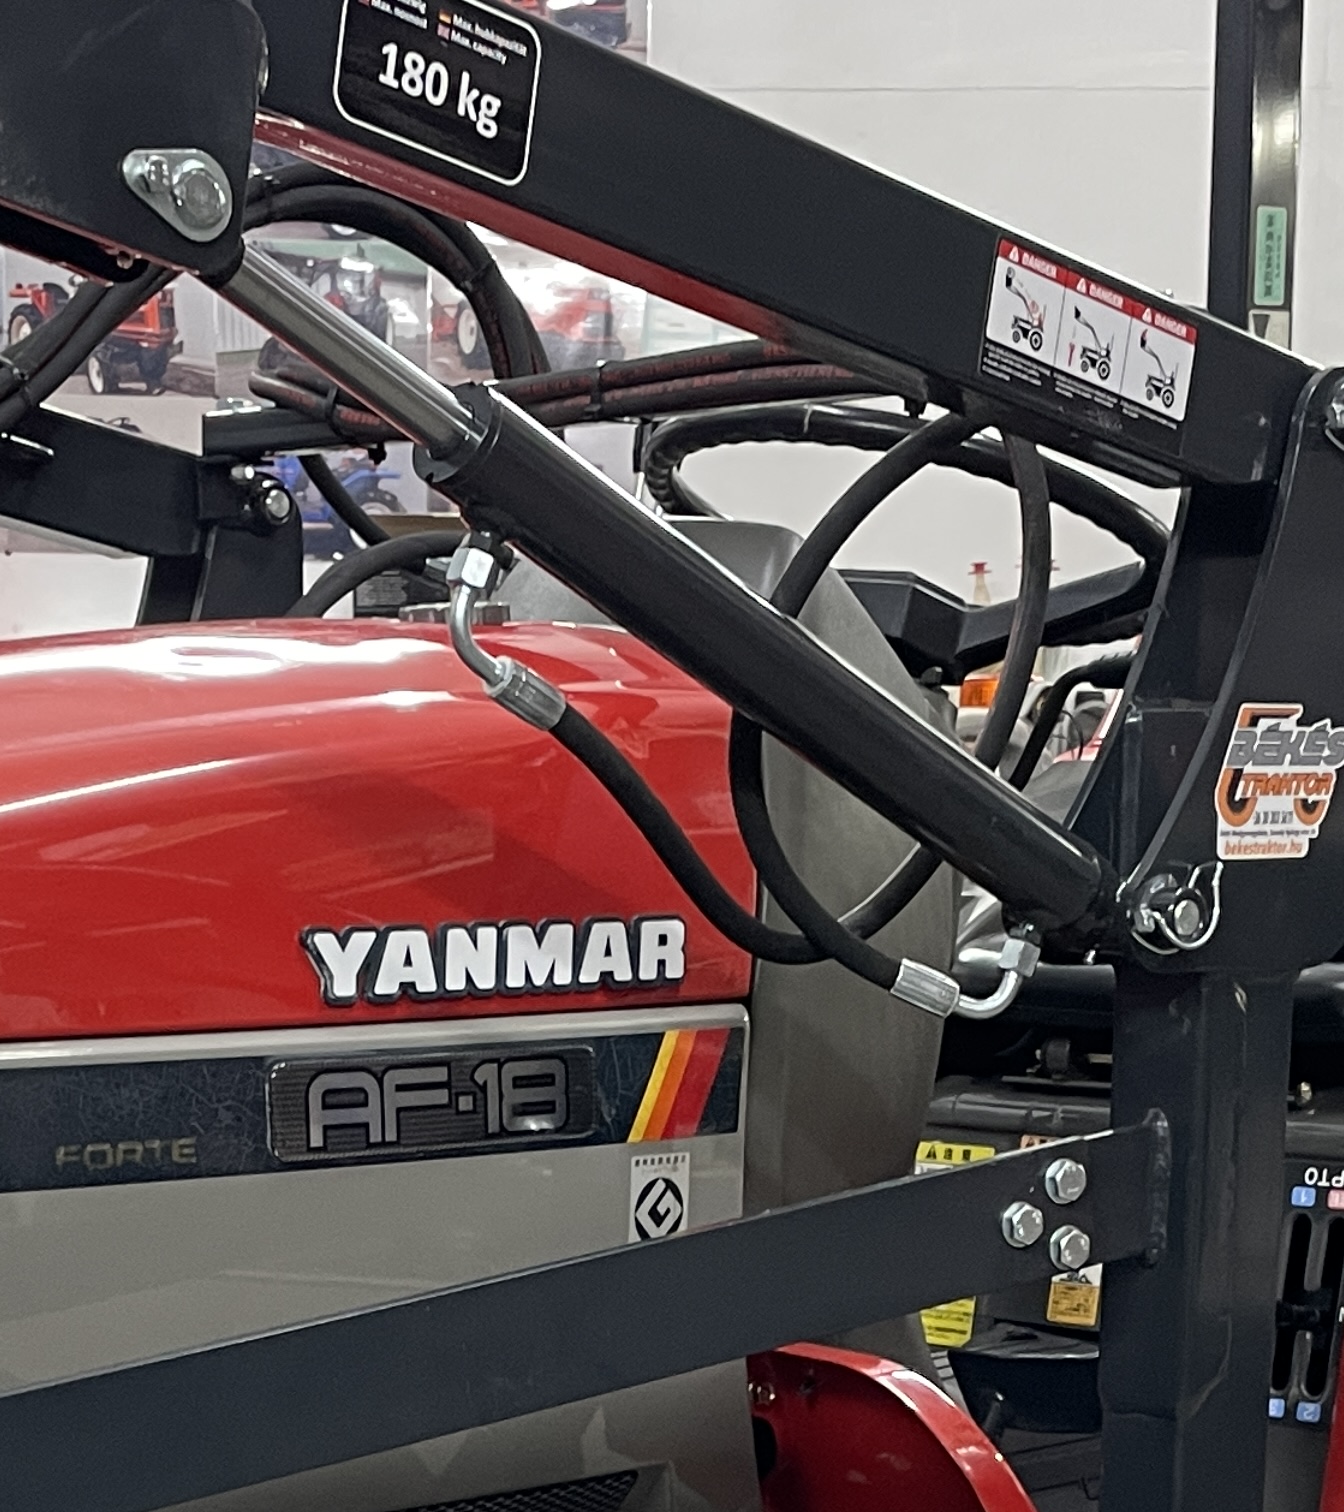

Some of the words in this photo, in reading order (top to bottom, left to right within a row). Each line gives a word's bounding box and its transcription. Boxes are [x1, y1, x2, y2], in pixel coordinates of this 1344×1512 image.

[378, 42, 449, 106] 180
[457, 71, 502, 139] kg
[1241, 773, 1334, 796] TRAKTOR
[306, 918, 686, 1000] YANMAR
[56, 1136, 197, 1171] FORTE
